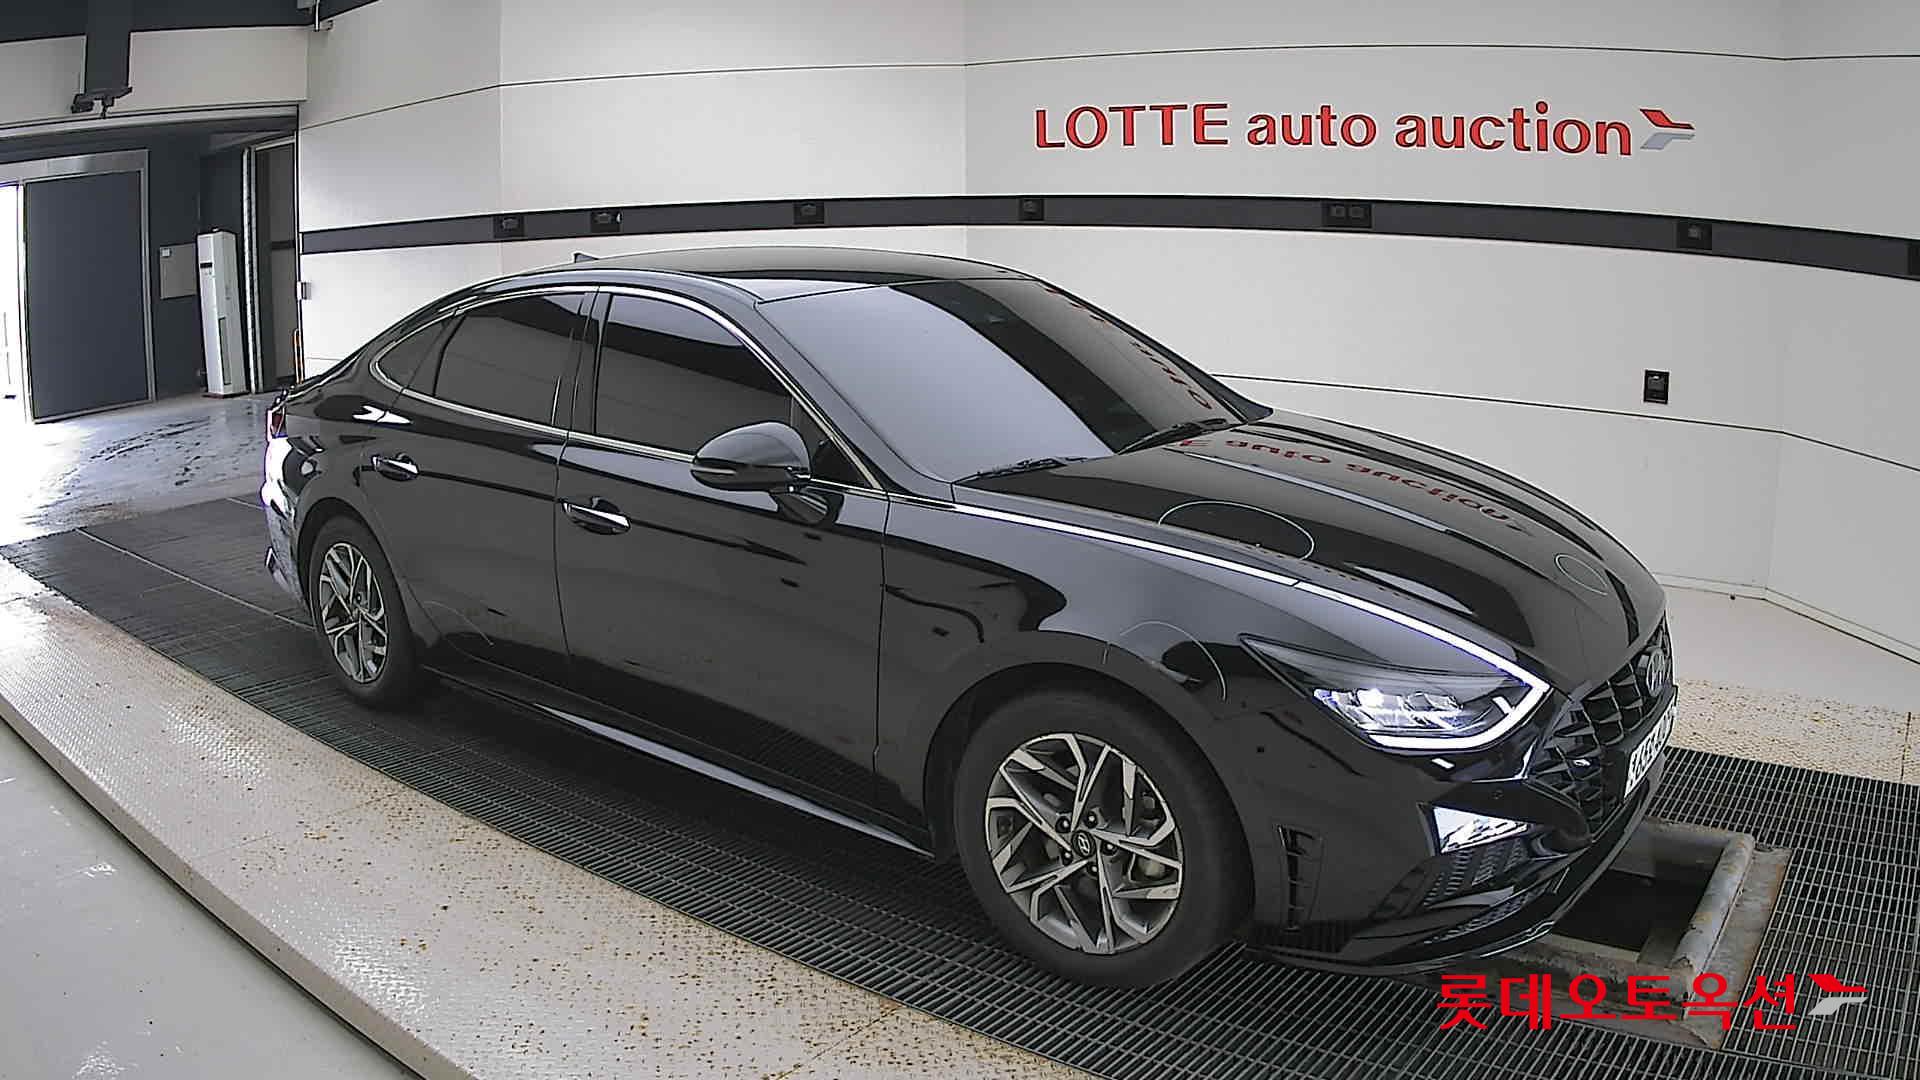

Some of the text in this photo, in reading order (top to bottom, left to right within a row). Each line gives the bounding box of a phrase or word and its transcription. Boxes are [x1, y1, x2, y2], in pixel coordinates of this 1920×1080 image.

[1035, 101, 1632, 156] LOTTE auto auction
